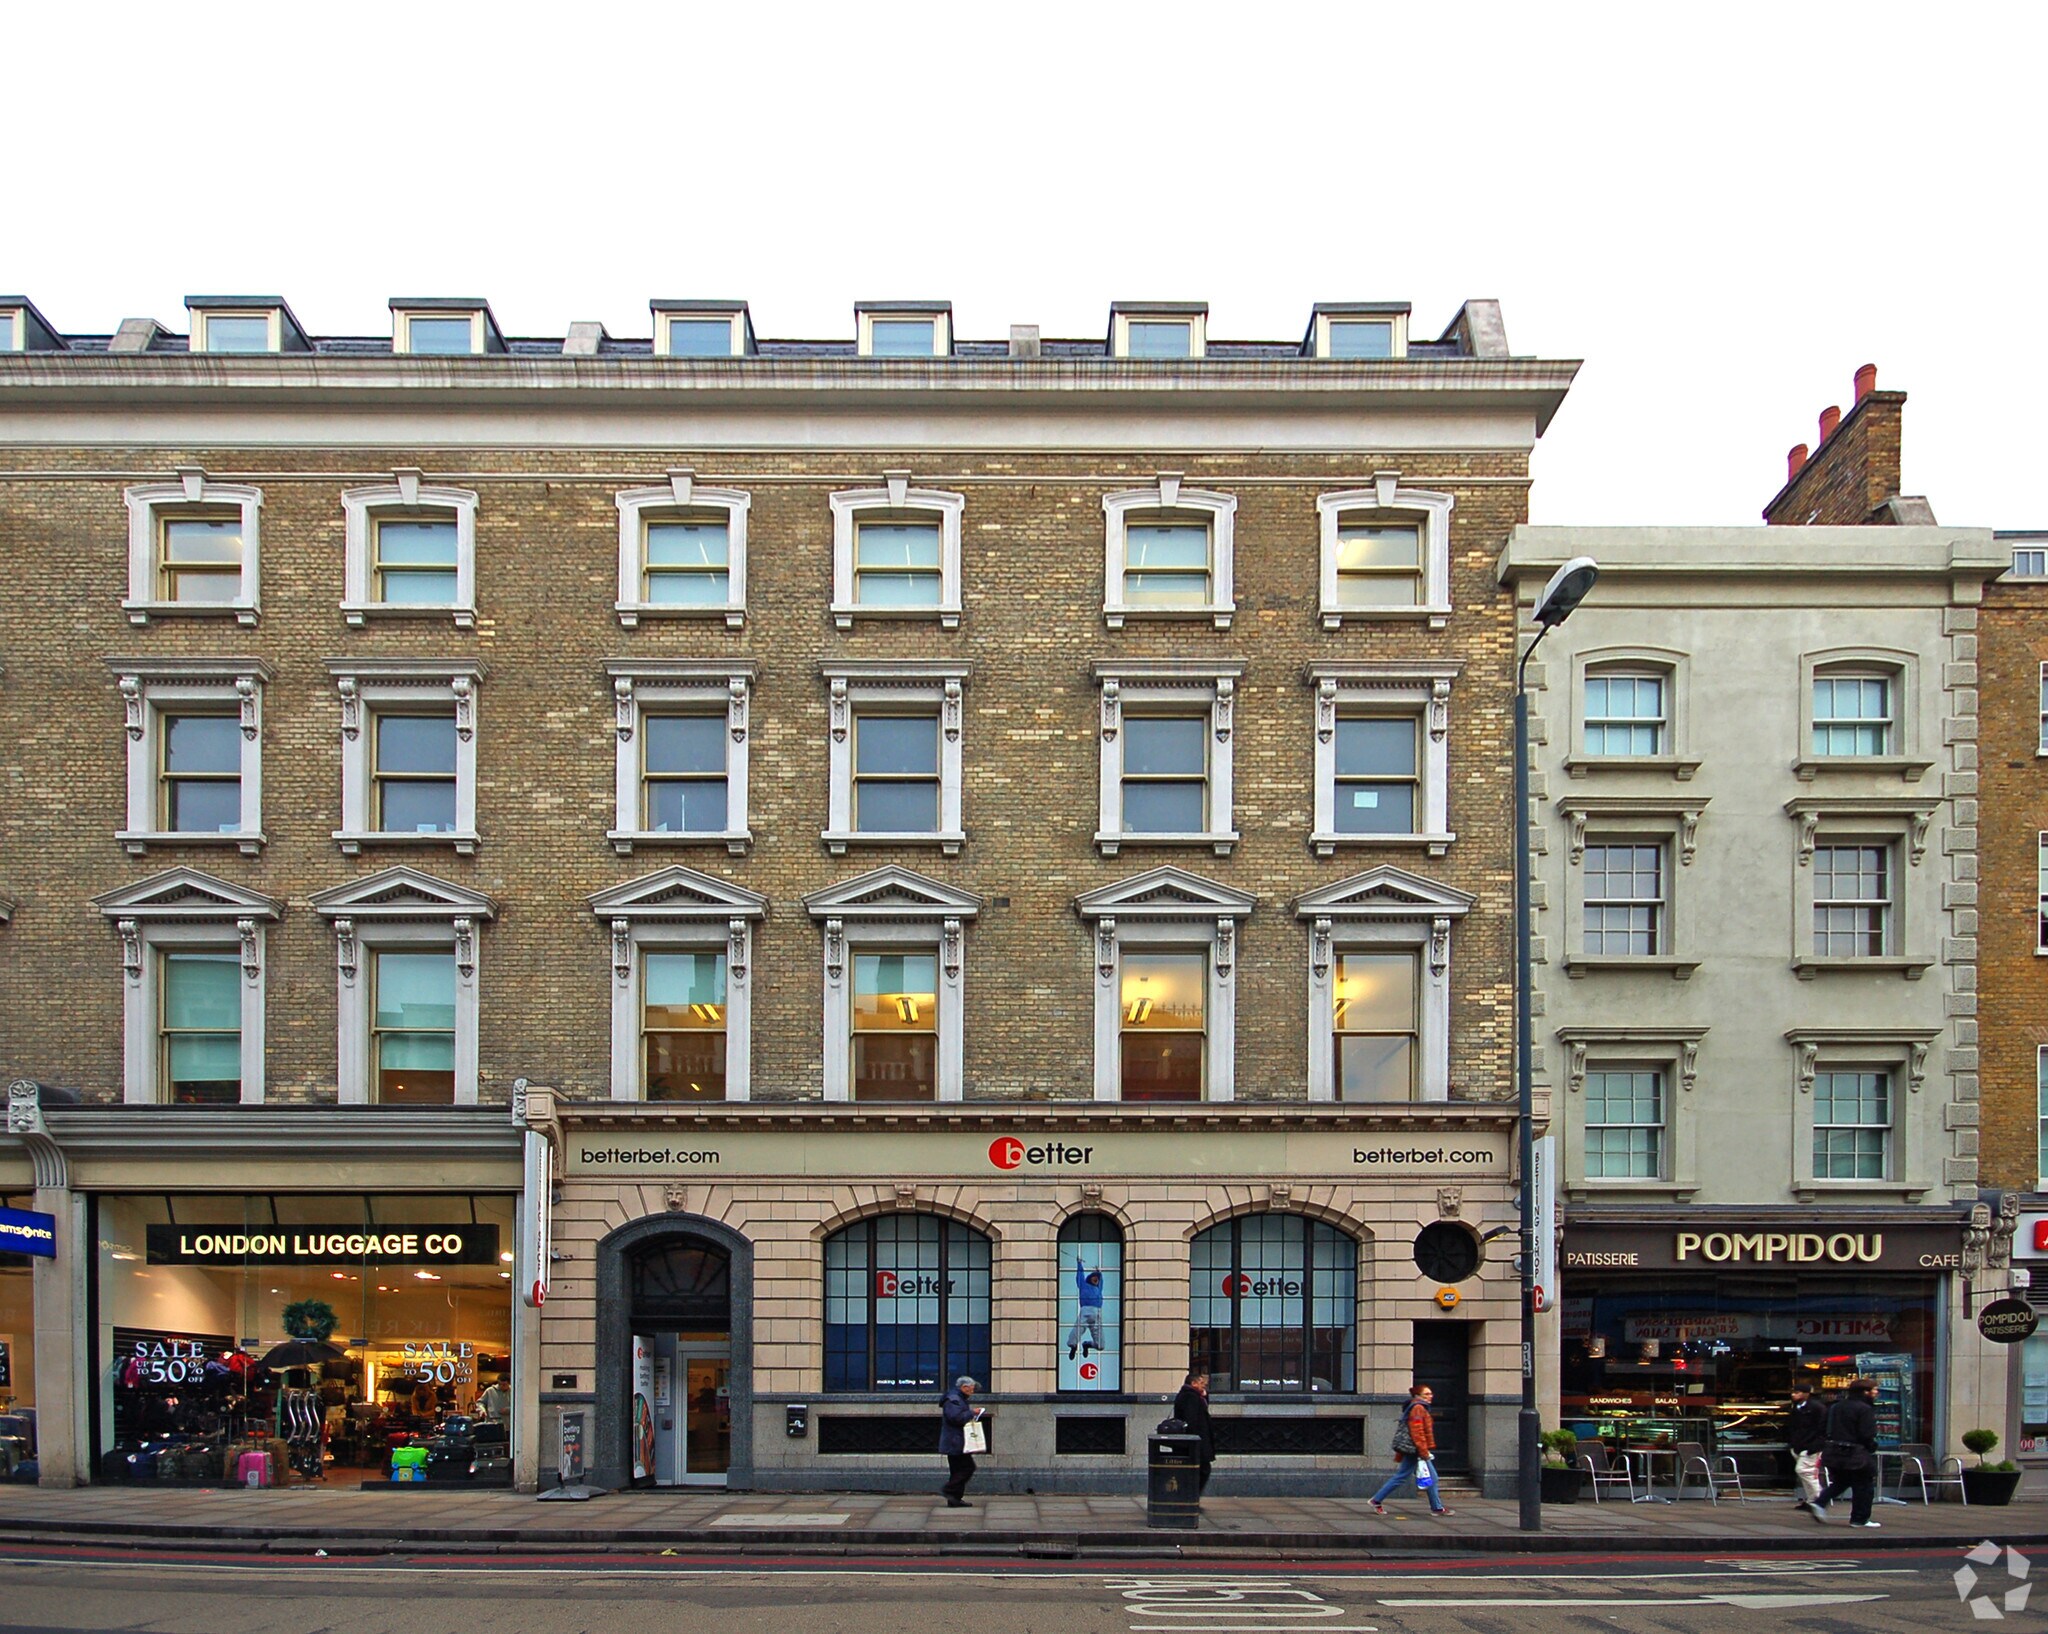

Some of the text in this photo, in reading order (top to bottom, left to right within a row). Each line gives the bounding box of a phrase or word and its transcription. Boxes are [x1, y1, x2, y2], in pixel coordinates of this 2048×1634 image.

[581, 1148, 720, 1163] betterbet.com
[997, 1139, 1093, 1167] better
[1353, 1148, 1493, 1163] betterbet.com
[180, 1234, 462, 1255] LONDON LUGGAGE CO
[1676, 1232, 1883, 1262] POMPIDOU
[1566, 1252, 1639, 1266] PATISSERIE
[1918, 1253, 1960, 1267] CAFE
[1979, 1312, 2034, 1326] POMPIDOU
[1983, 1325, 2028, 1335] PATISSERIE
[136, 1341, 204, 1358] SALE
[404, 1342, 473, 1358] SALE
